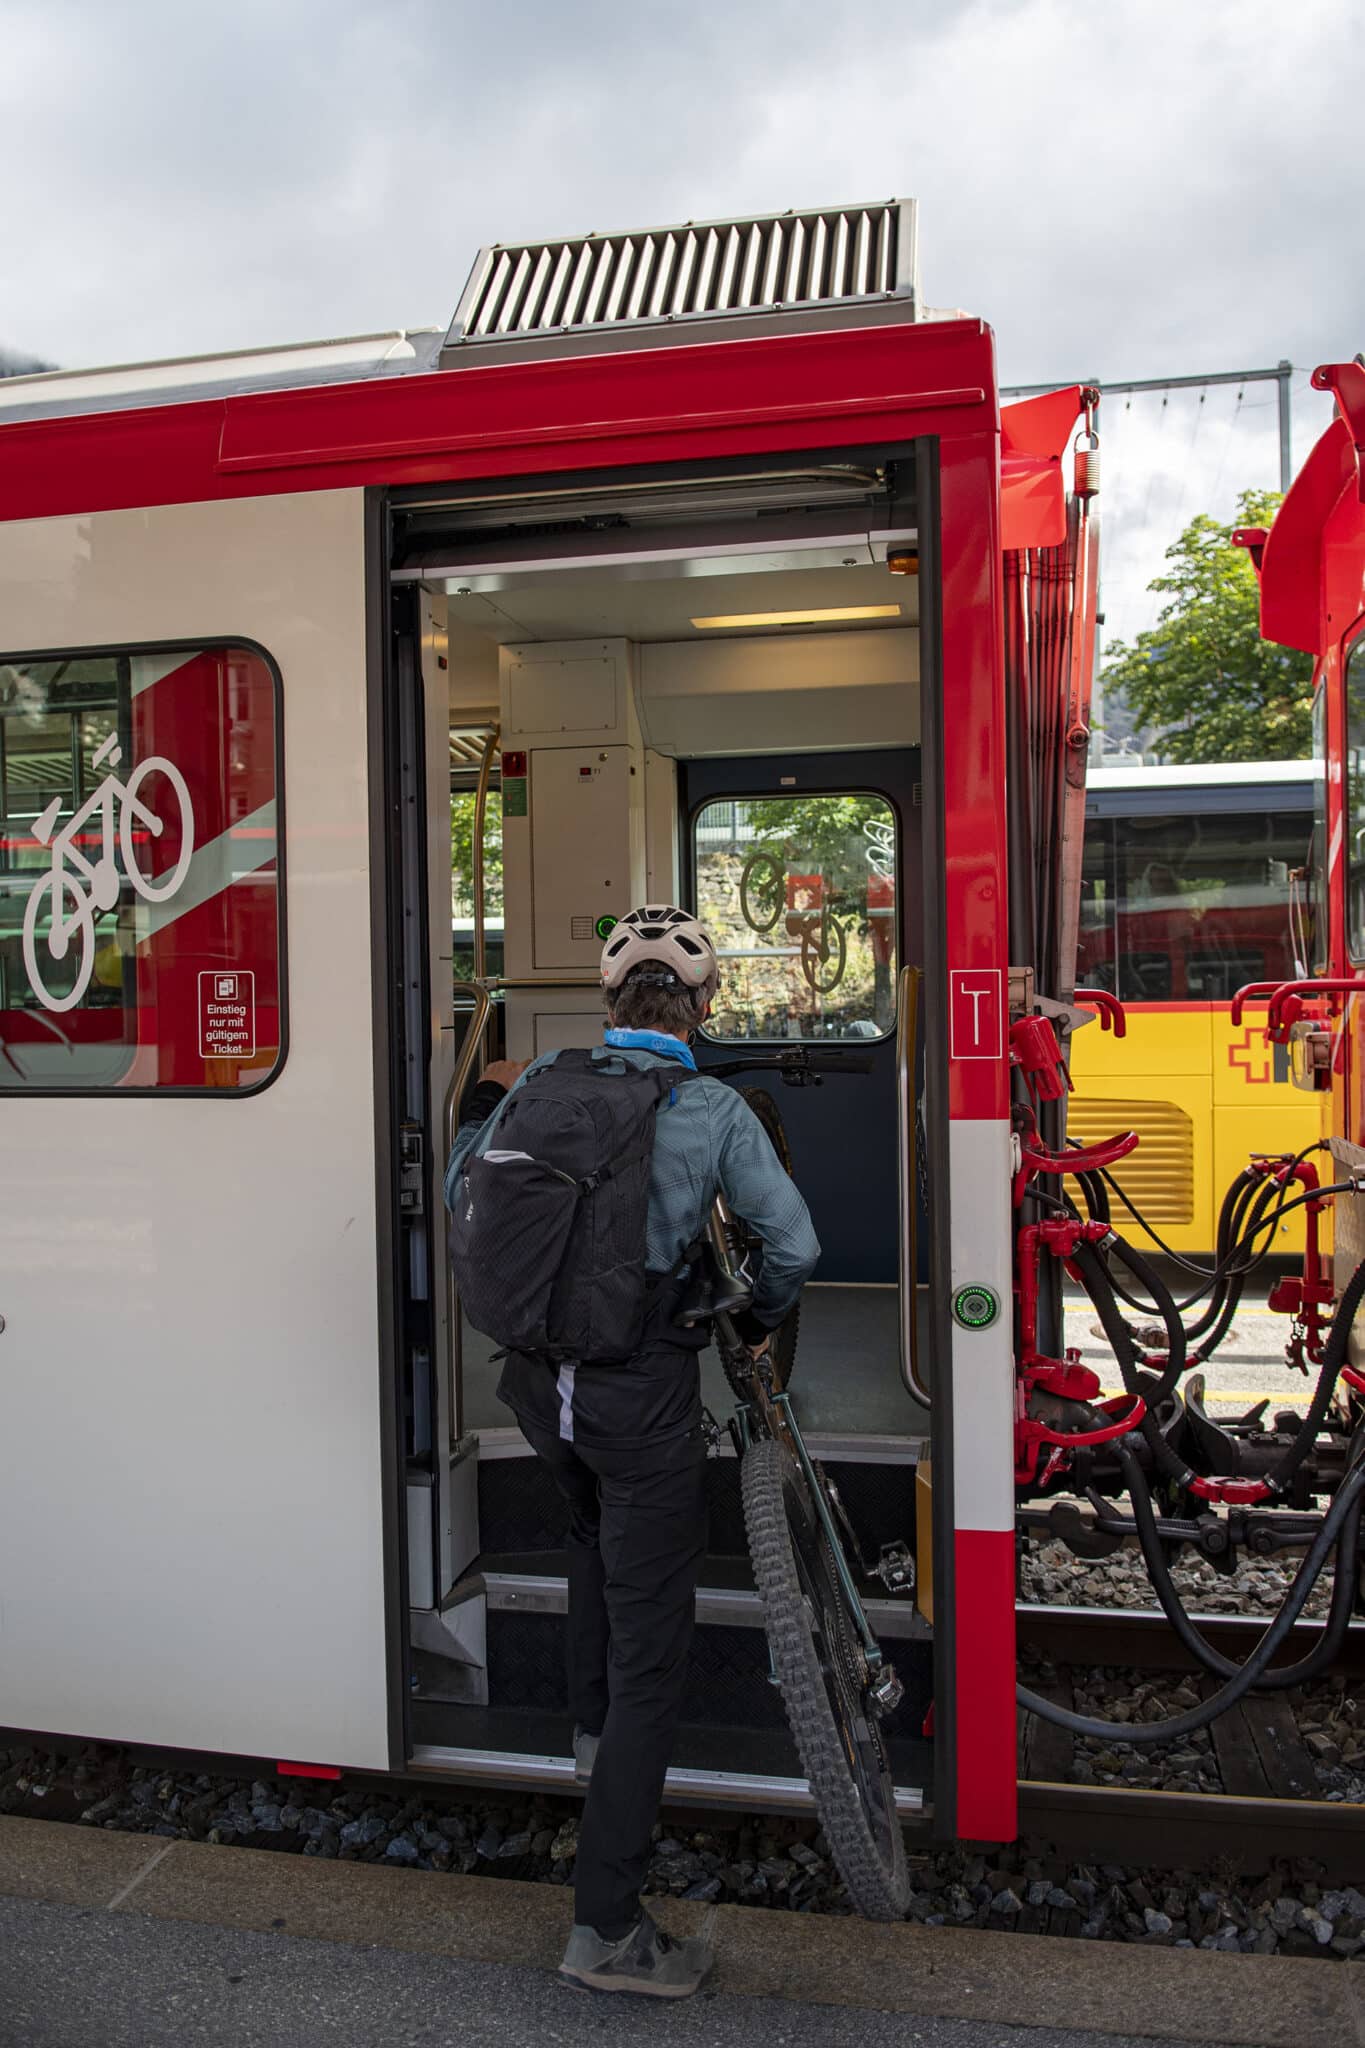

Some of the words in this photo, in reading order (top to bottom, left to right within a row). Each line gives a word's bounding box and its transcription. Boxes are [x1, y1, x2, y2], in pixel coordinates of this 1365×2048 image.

[207, 1004, 246, 1016] Einstieg
[209, 1019, 225, 1027] nur
[228, 1018, 244, 1027] mit
[206, 1030, 248, 1042] gültigem
[212, 1044, 242, 1054] Ticket
